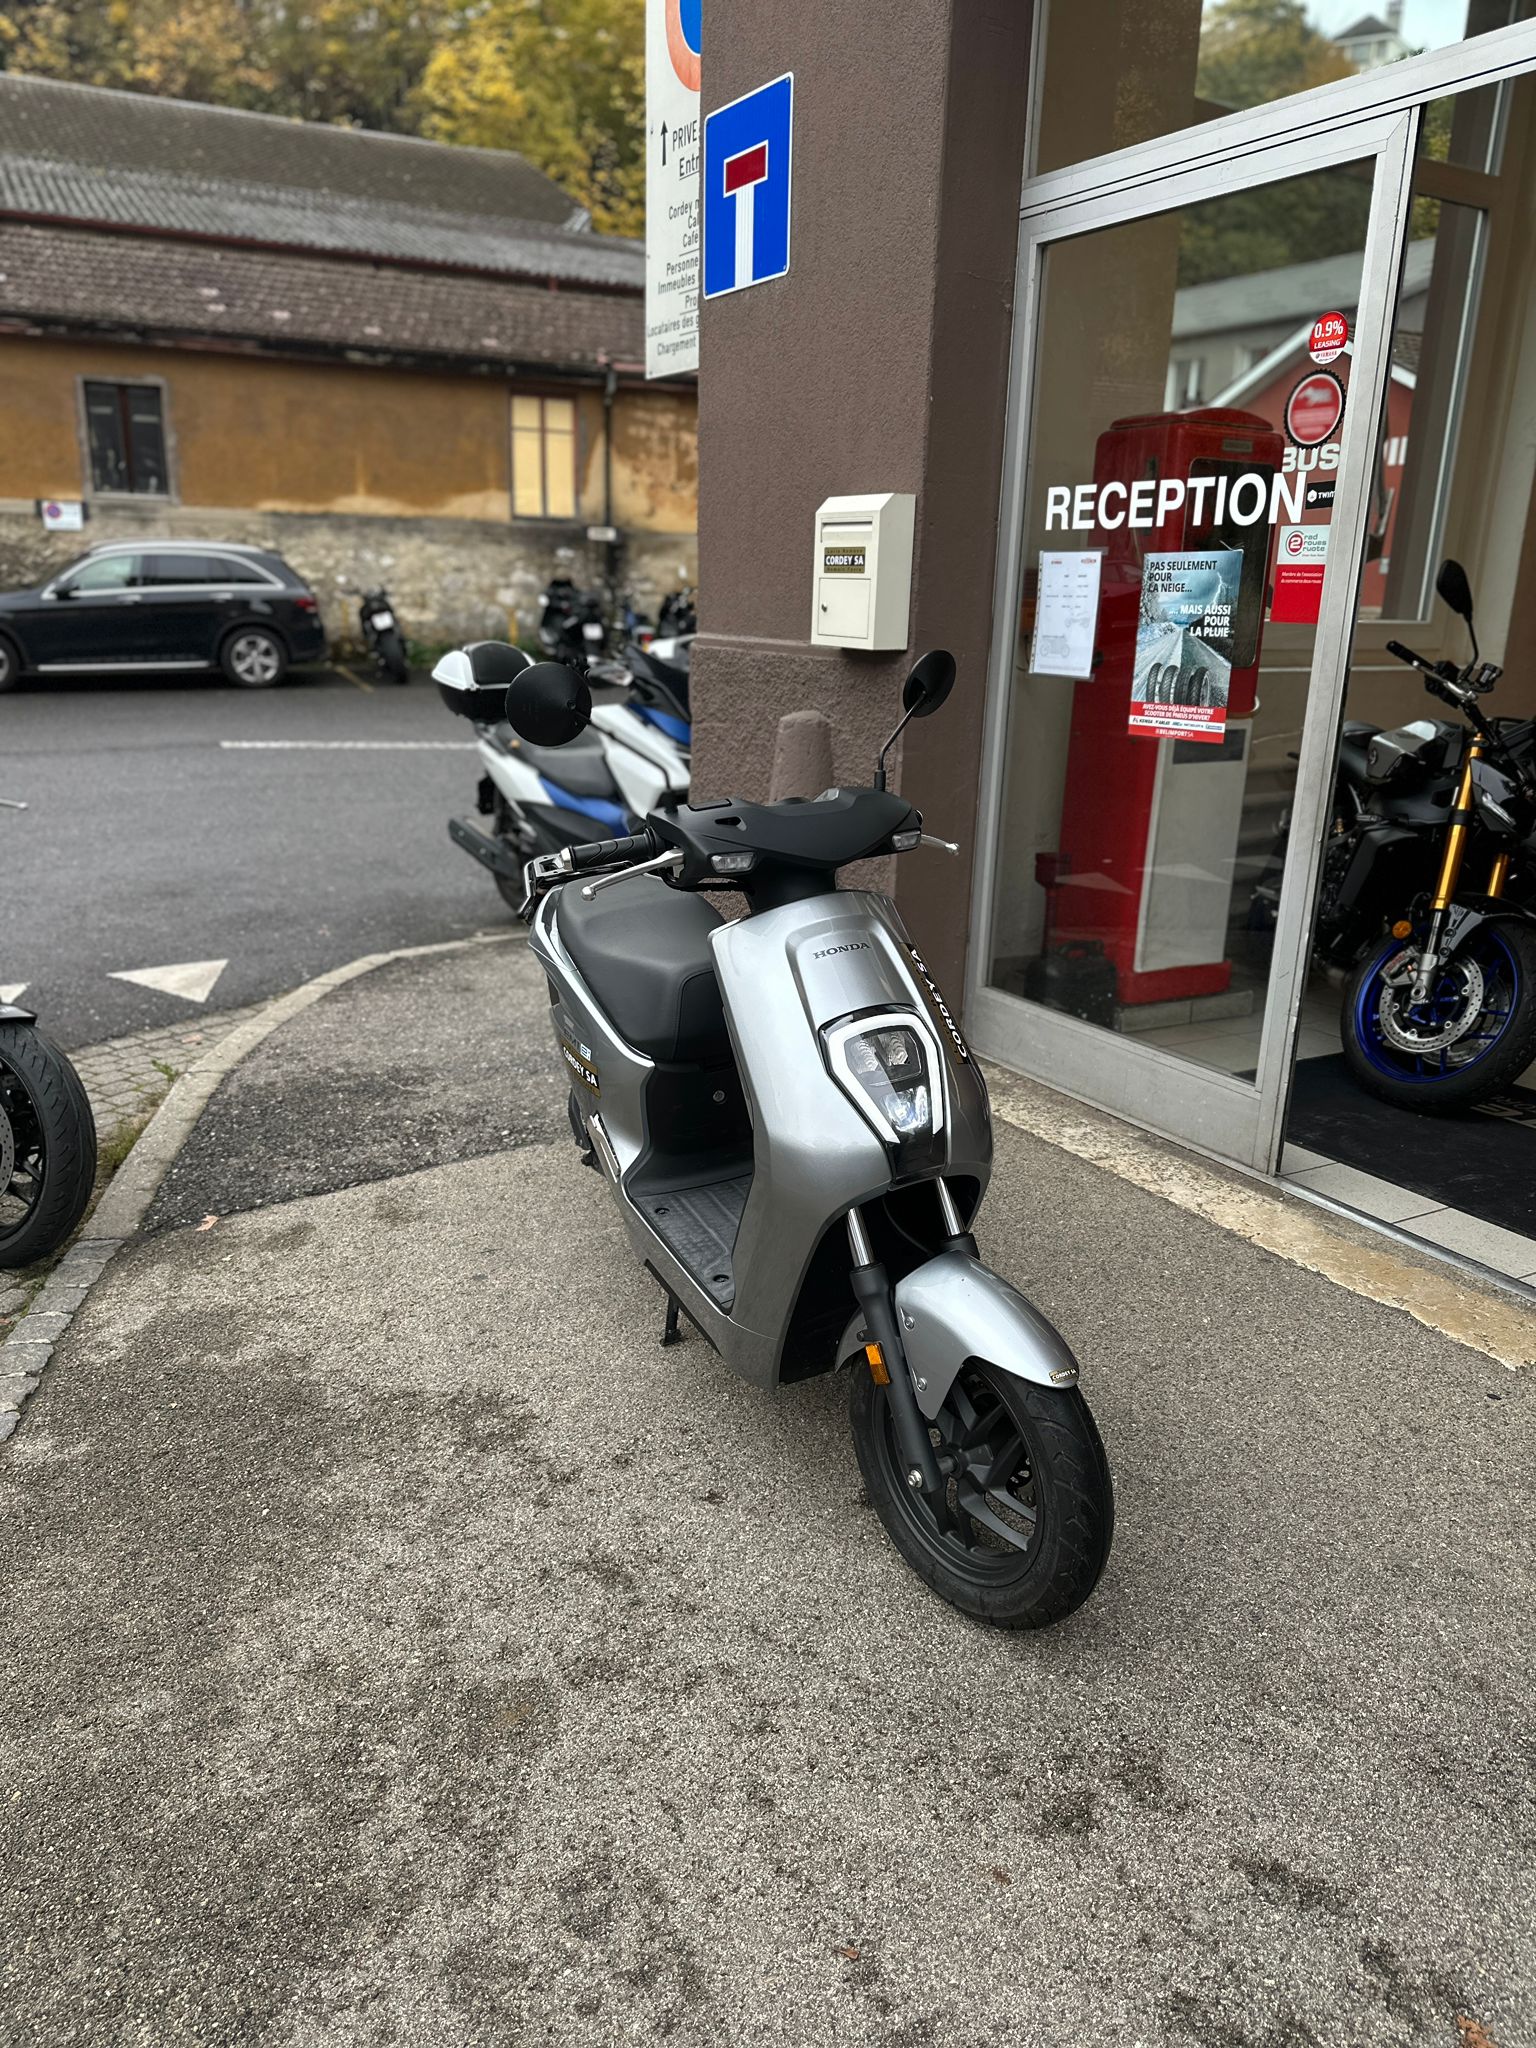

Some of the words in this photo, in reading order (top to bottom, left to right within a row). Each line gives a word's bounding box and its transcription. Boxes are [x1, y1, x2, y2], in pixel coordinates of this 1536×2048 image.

[668, 200, 693, 220] Cordey
[657, 273, 696, 295] Immeubles
[681, 316, 694, 329] des
[1314, 319, 1344, 338] 0.9%
[657, 336, 696, 357] Chargement
[1314, 339, 1342, 349] LEASING
[1044, 471, 1307, 531] RECEPTION
[1304, 533, 1319, 541] rad
[826, 556, 852, 565] CORDEY
[854, 556, 864, 565] SA
[1149, 561, 1166, 572] PAS
[1166, 560, 1218, 571] SEULEMENT
[1148, 572, 1173, 582] POUR
[1147, 583, 1160, 593] LA
[1160, 582, 1193, 593] NEIGE...
[1180, 604, 1204, 615] MAIS
[1204, 604, 1232, 615] AUSSI
[1203, 615, 1231, 626] POUR
[1189, 626, 1203, 637] LA
[1203, 626, 1231, 638] PLUIE
[1197, 707, 1214, 715] VOTRE
[812, 942, 870, 959] HONDA
[911, 949, 927, 973] SA
[926, 978, 967, 1058] CORDEY
[586, 1070, 597, 1086] SA
